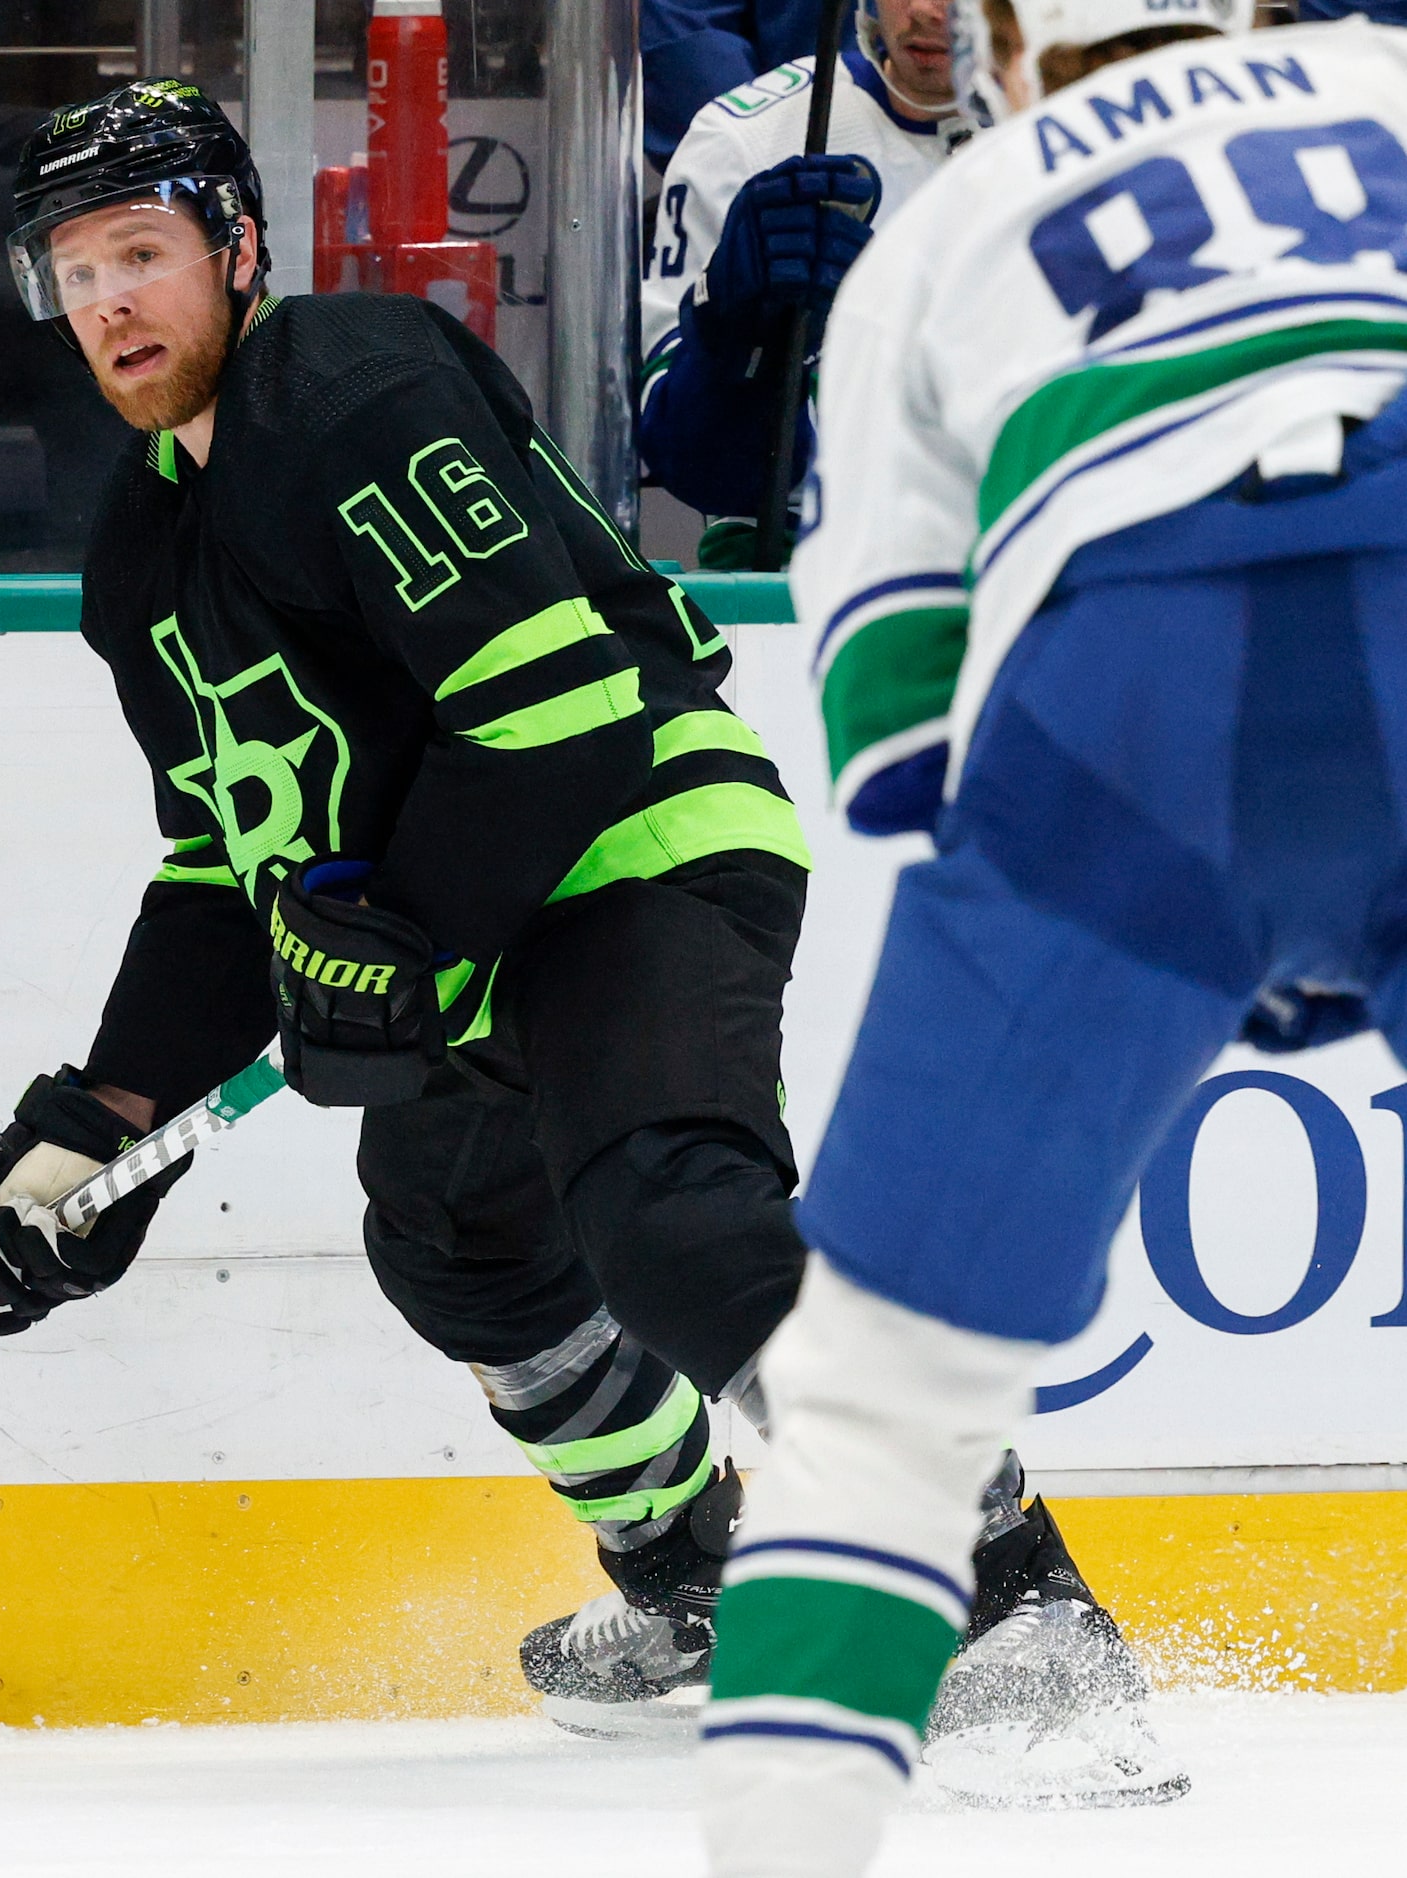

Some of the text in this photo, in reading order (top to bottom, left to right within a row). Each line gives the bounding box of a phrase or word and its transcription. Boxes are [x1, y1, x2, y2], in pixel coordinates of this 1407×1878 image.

[53, 106, 87, 136] 16
[40, 144, 101, 176] WARRIOR
[337, 438, 529, 613] 16
[270, 890, 397, 994] RRIOR
